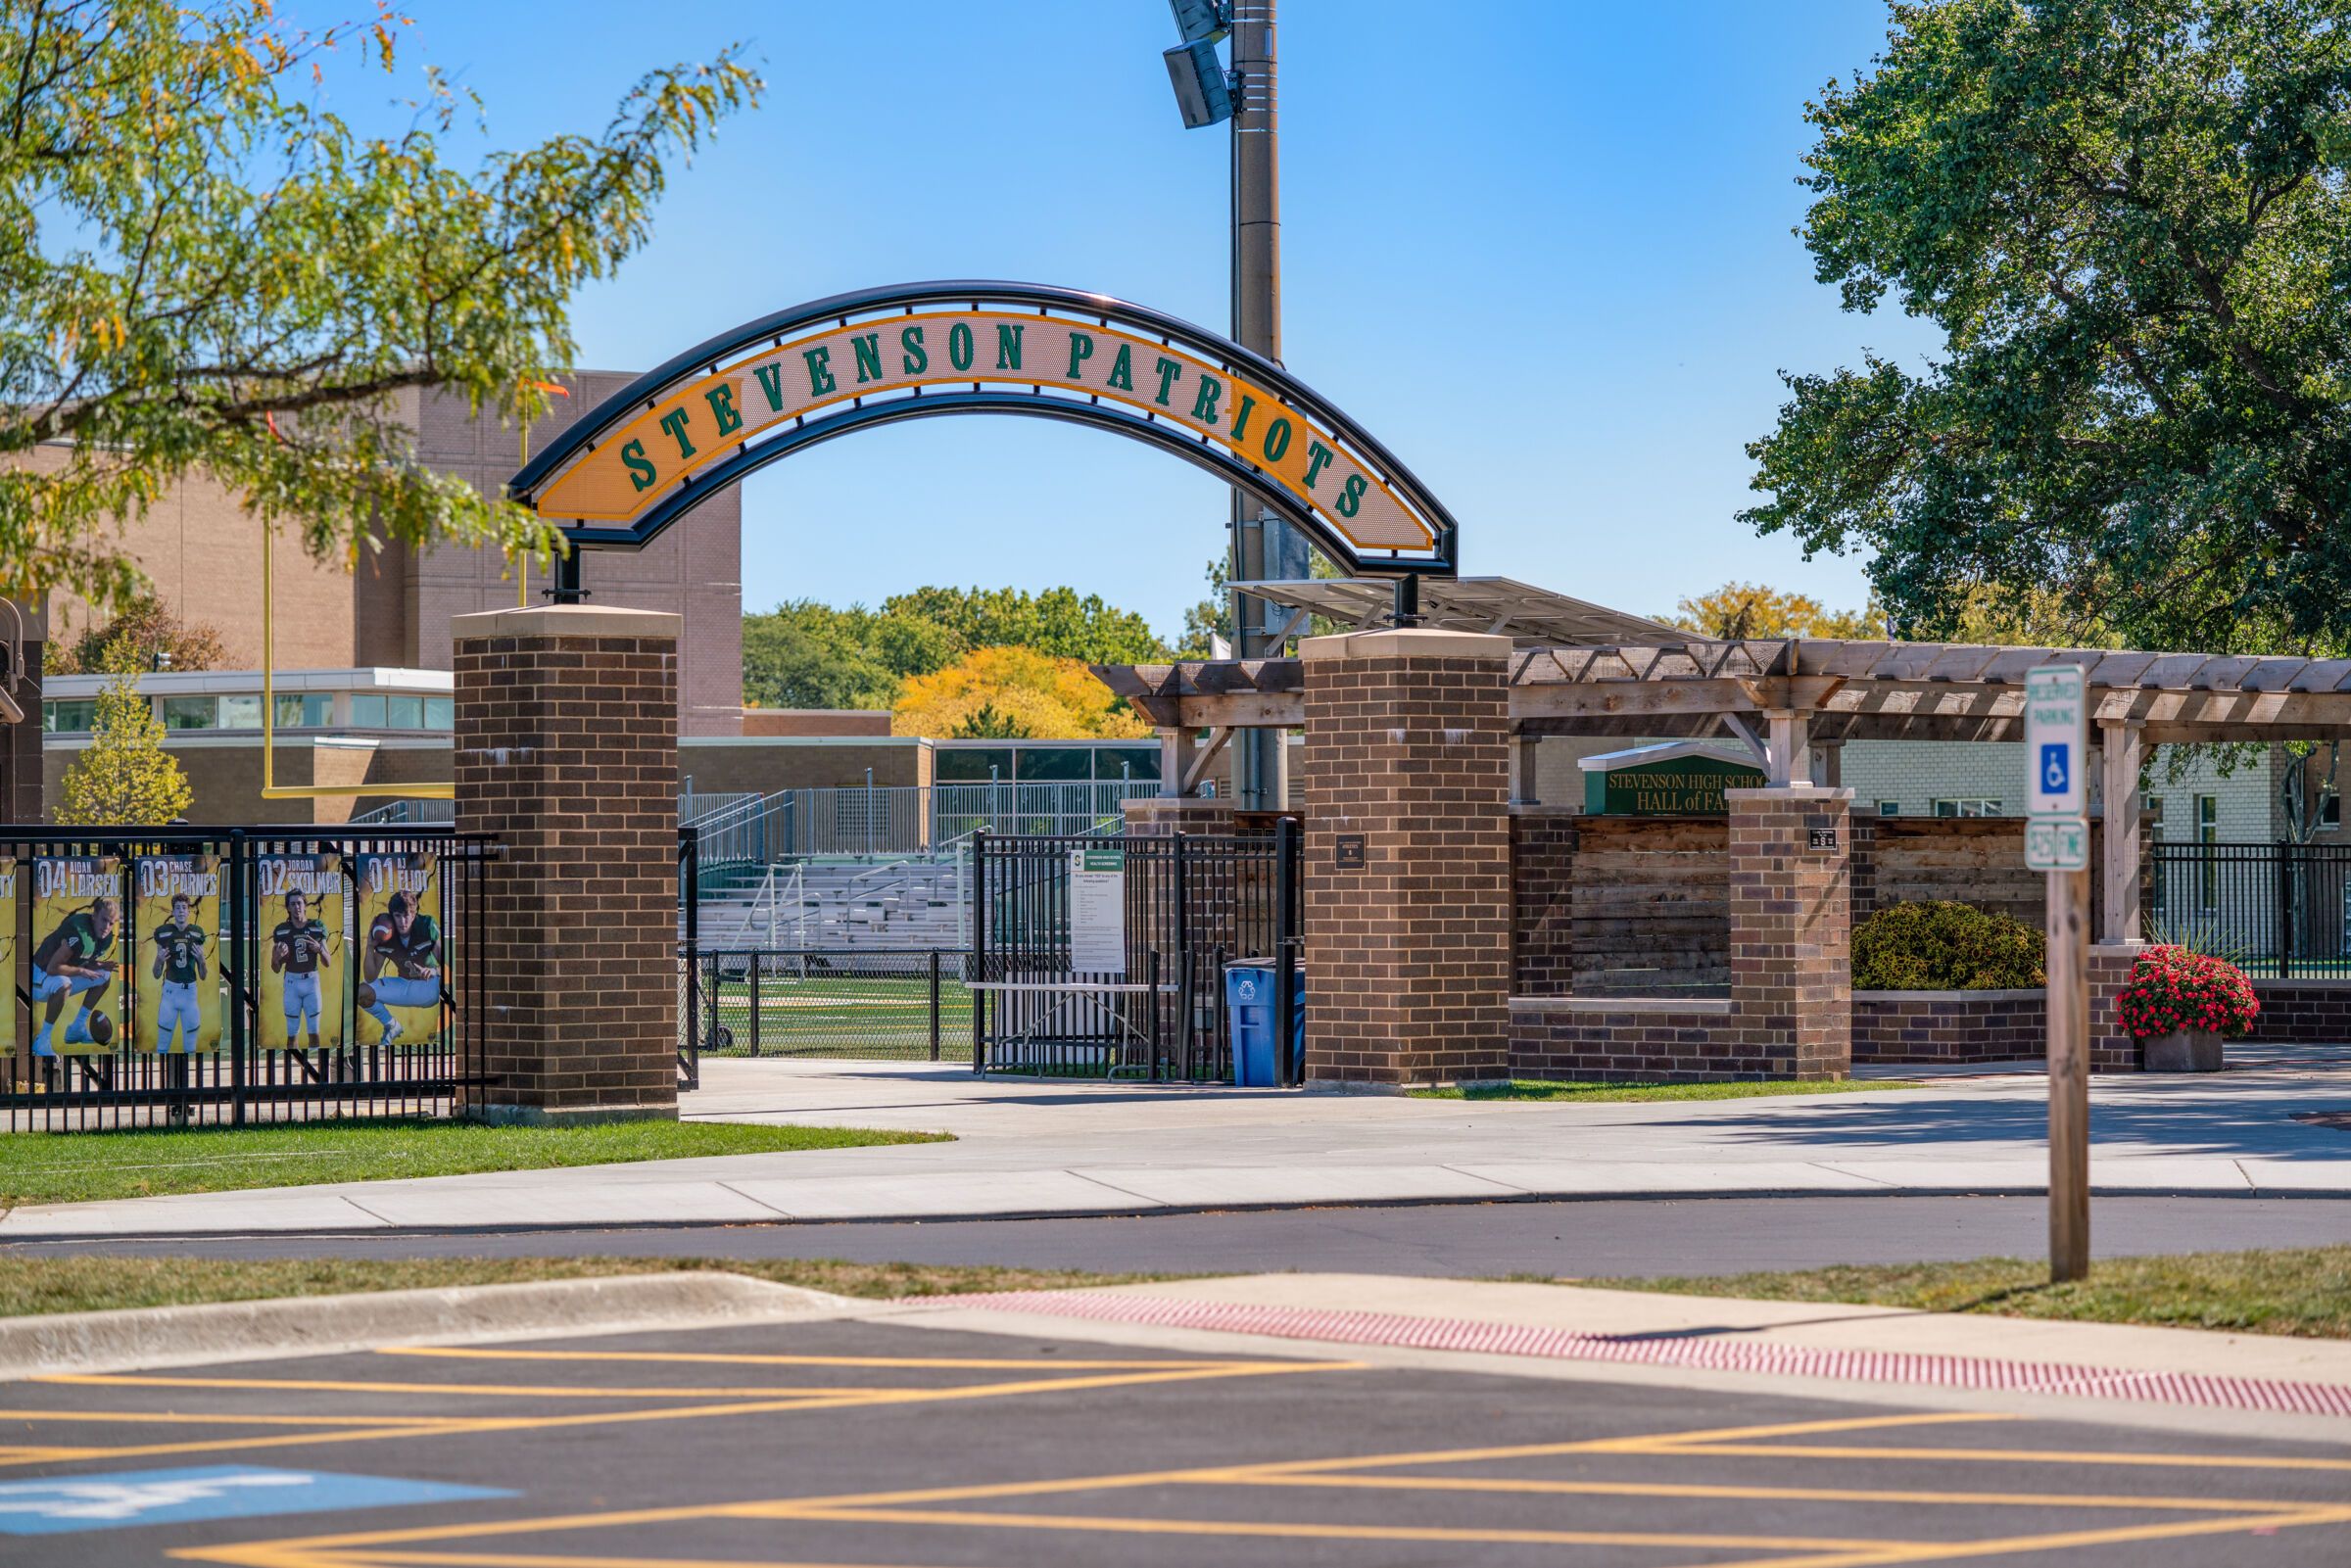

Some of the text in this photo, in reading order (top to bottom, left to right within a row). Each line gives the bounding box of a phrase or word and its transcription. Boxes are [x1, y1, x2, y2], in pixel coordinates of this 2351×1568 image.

[620, 322, 1368, 519] STEVENSON PATRIOTS
[2034, 707, 2075, 726] PARKING
[1608, 773, 1686, 789] STEVENSON
[1689, 774, 1722, 789] HIGH
[1637, 791, 1682, 811] HALL
[1685, 790, 1702, 811] of
[70, 861, 92, 874] AIDAN
[169, 862, 193, 873] CHASE
[287, 859, 314, 872] JORDAN
[397, 857, 407, 870] AJ
[38, 861, 68, 898] 04
[71, 874, 119, 897] LARSEN
[141, 860, 169, 897] 03
[170, 874, 217, 896] PARNES
[259, 859, 287, 896] 02
[288, 871, 343, 894] SKOLMAR
[368, 857, 395, 894] 01
[397, 869, 428, 893] ELIOT
[176, 943, 187, 969] 3
[295, 938, 309, 964] 2
